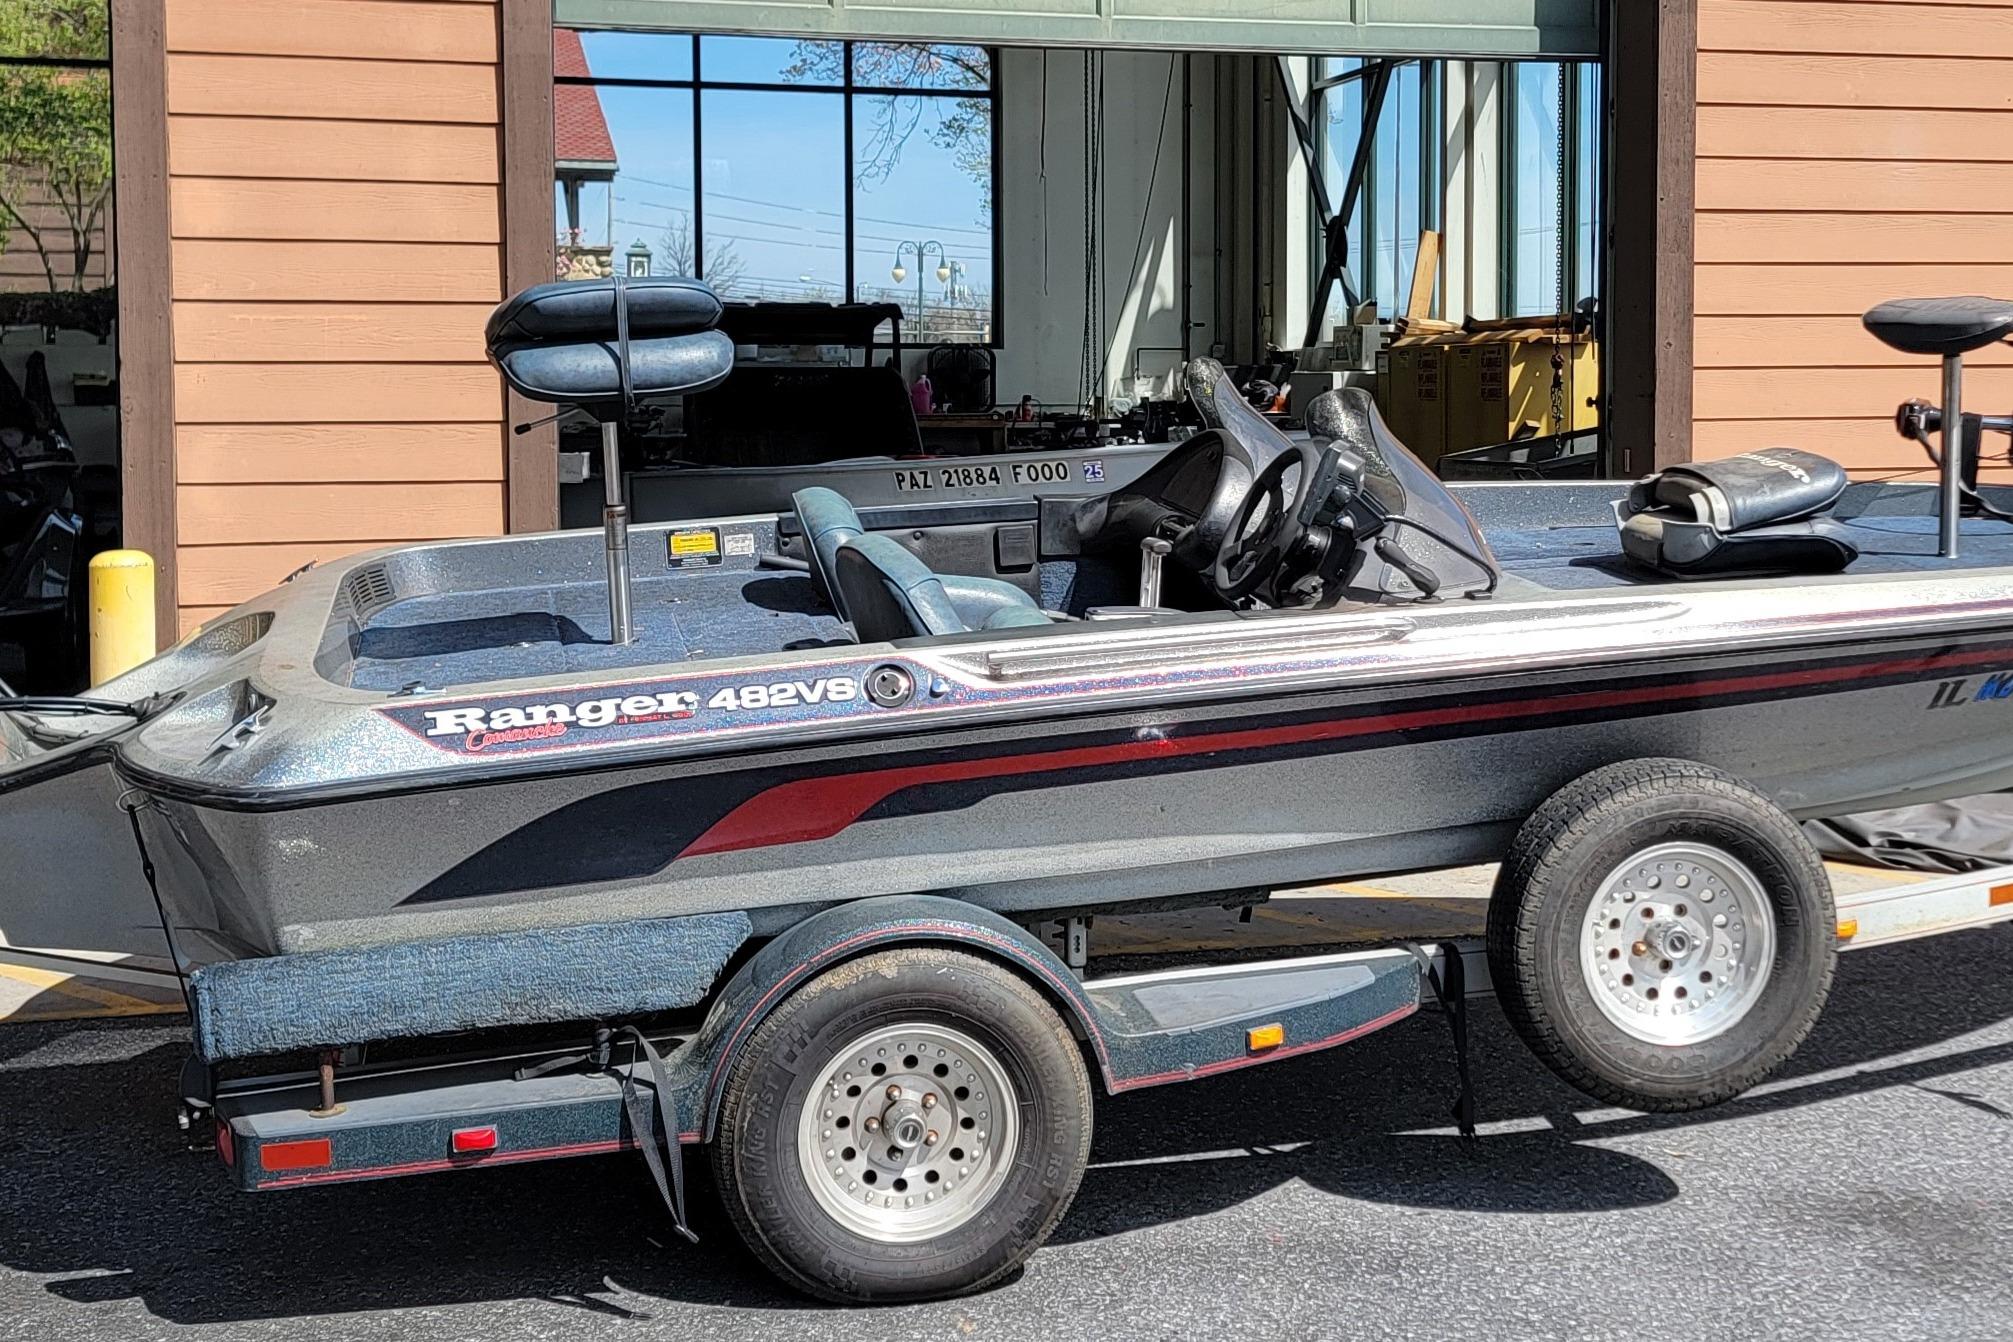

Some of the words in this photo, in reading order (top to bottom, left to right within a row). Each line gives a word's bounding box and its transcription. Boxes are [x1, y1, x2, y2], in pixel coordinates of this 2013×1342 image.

[896, 470, 932, 490] PAZ
[942, 466, 1000, 487] 21884
[1085, 465, 1103, 478] 25
[425, 691, 697, 735] Ranger
[709, 677, 856, 710] 482VS
[465, 719, 567, 751] Comanche
